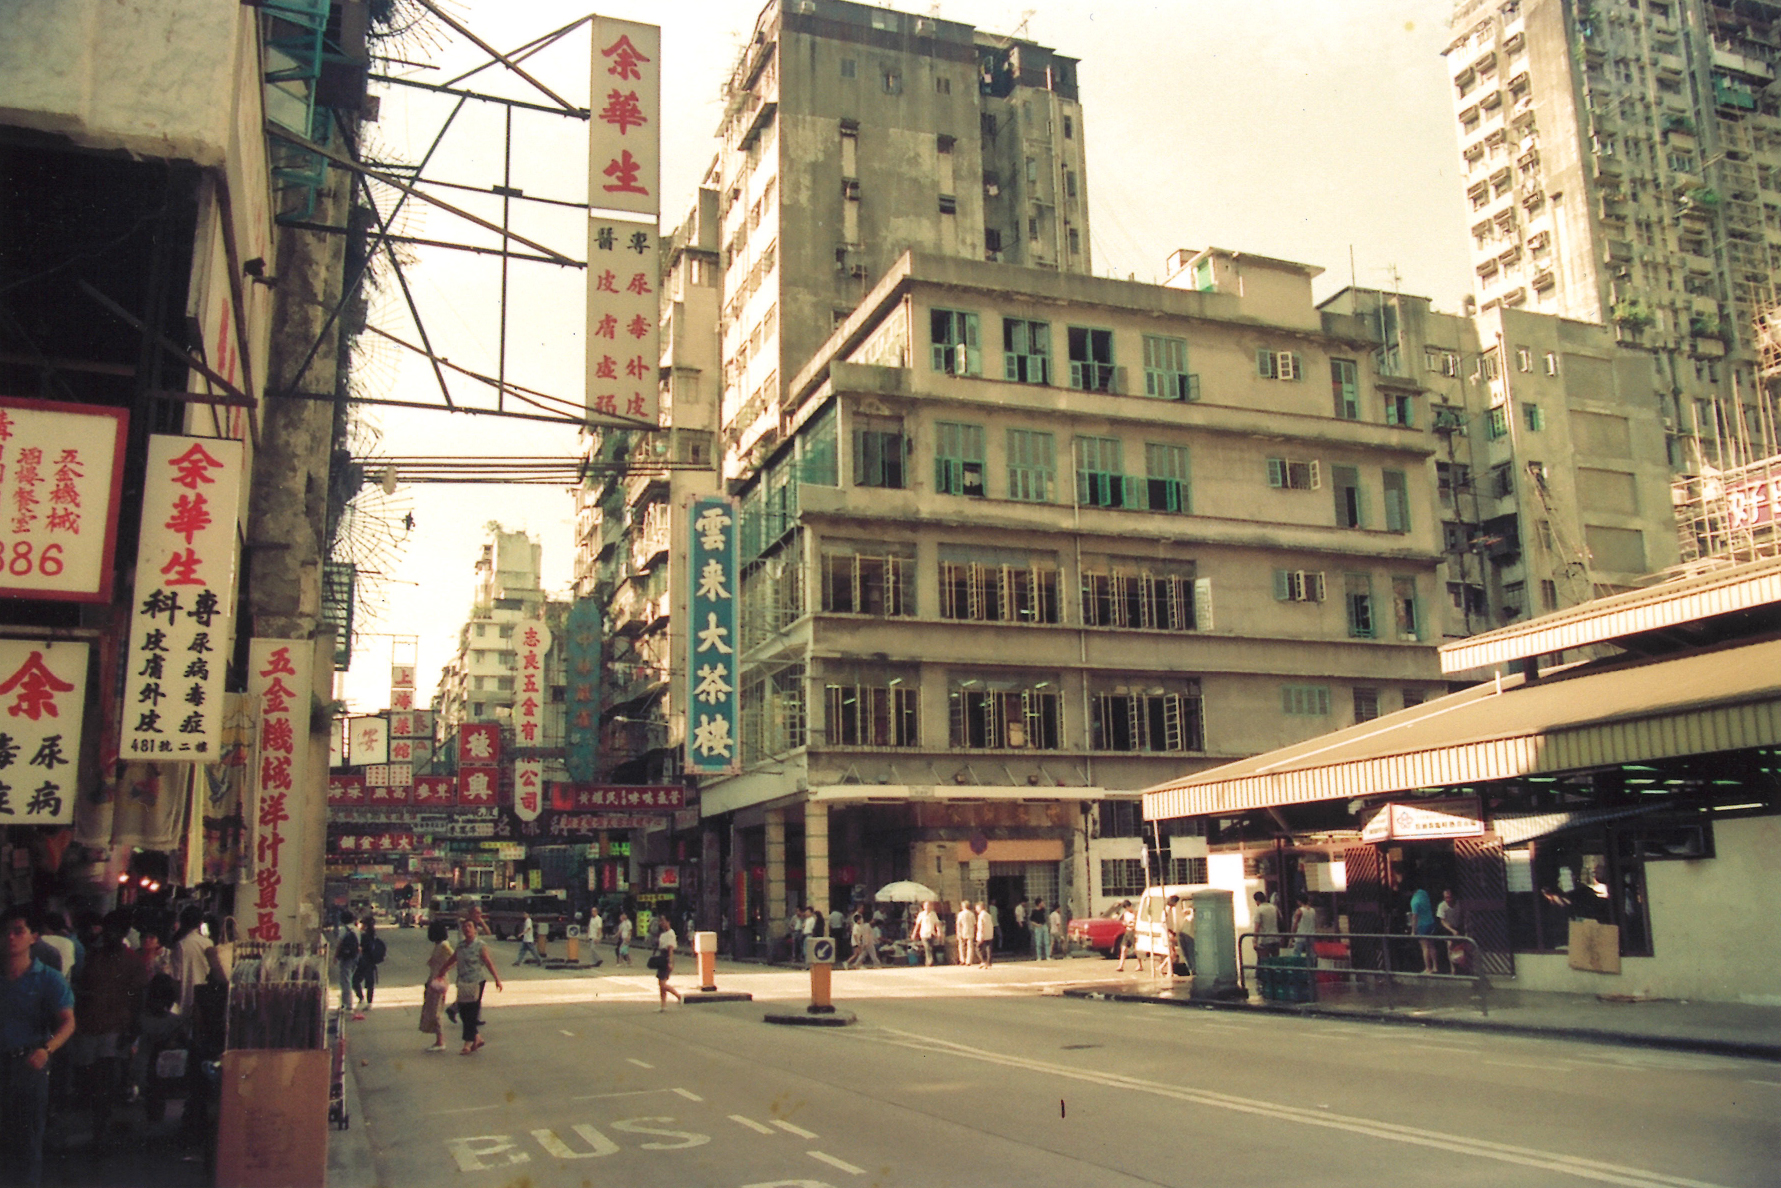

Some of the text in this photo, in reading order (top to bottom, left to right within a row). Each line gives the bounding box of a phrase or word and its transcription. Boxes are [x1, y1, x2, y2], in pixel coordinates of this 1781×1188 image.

[599, 34, 651, 196] 余華生
[0, 541, 64, 577] 86
[160, 443, 224, 586] 余華生
[519, 627, 541, 813] 志良五金有公司
